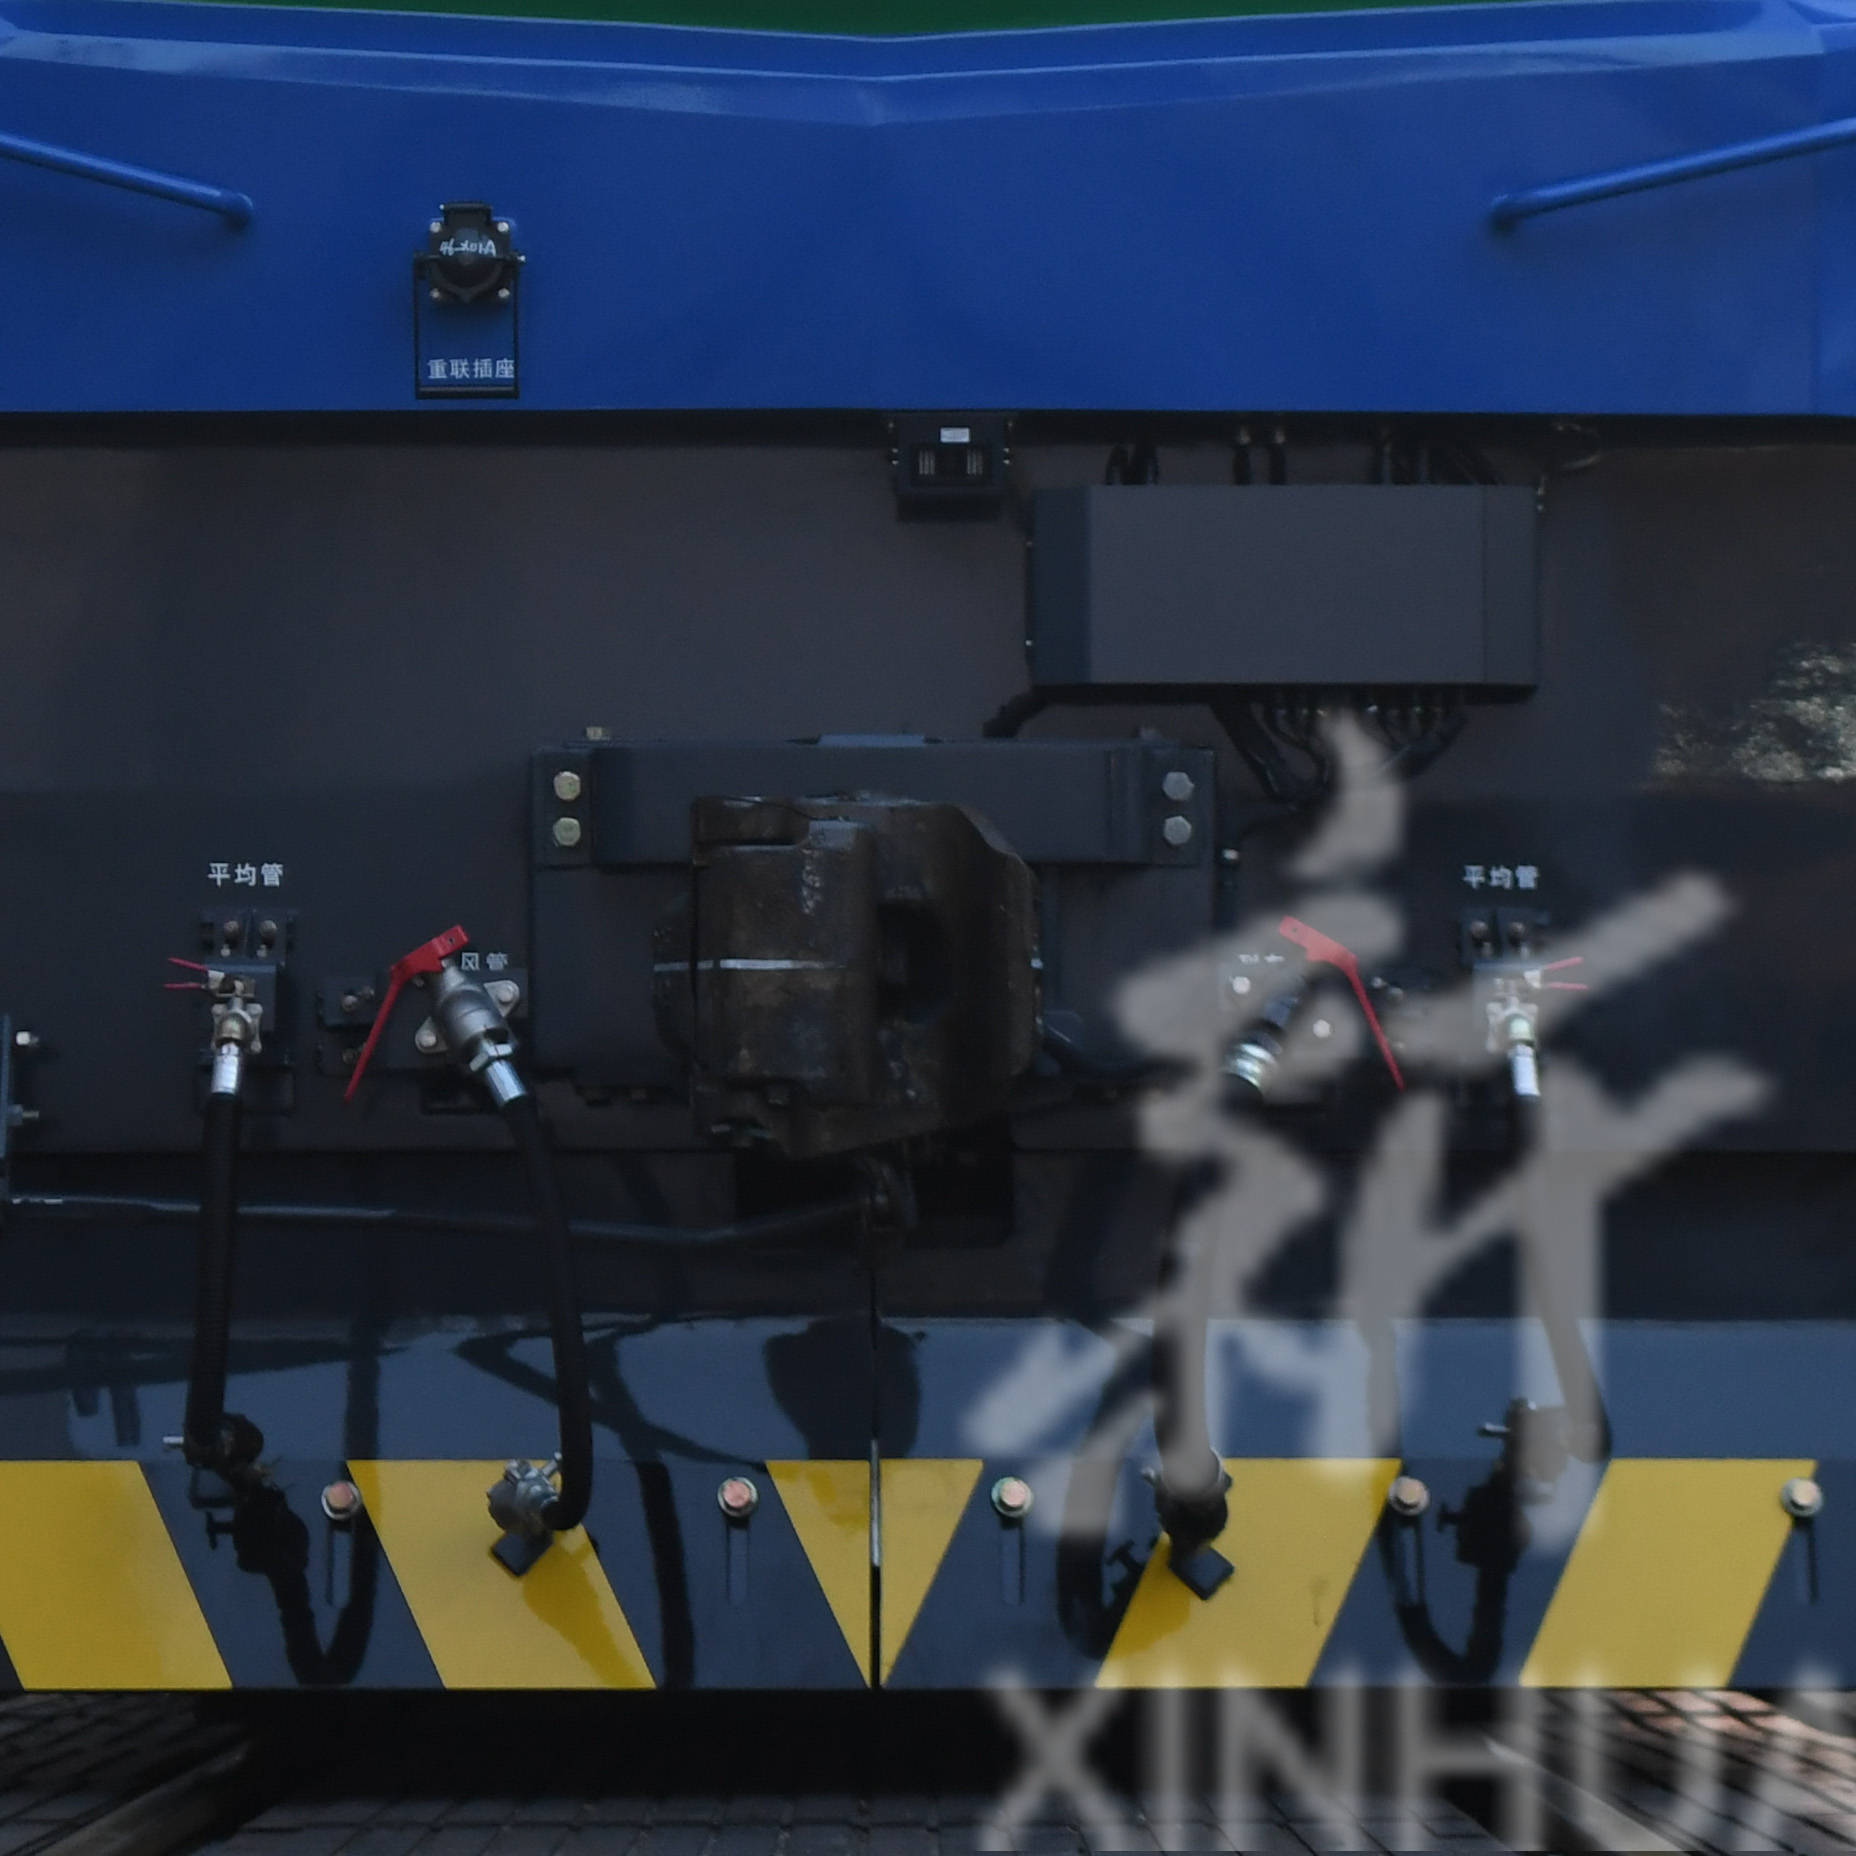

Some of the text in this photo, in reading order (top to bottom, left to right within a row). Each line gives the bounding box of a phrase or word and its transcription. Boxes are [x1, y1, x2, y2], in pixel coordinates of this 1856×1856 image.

[427, 357, 515, 380] 重联插座
[207, 862, 284, 888] 平均管
[1463, 864, 1540, 889] 平均管
